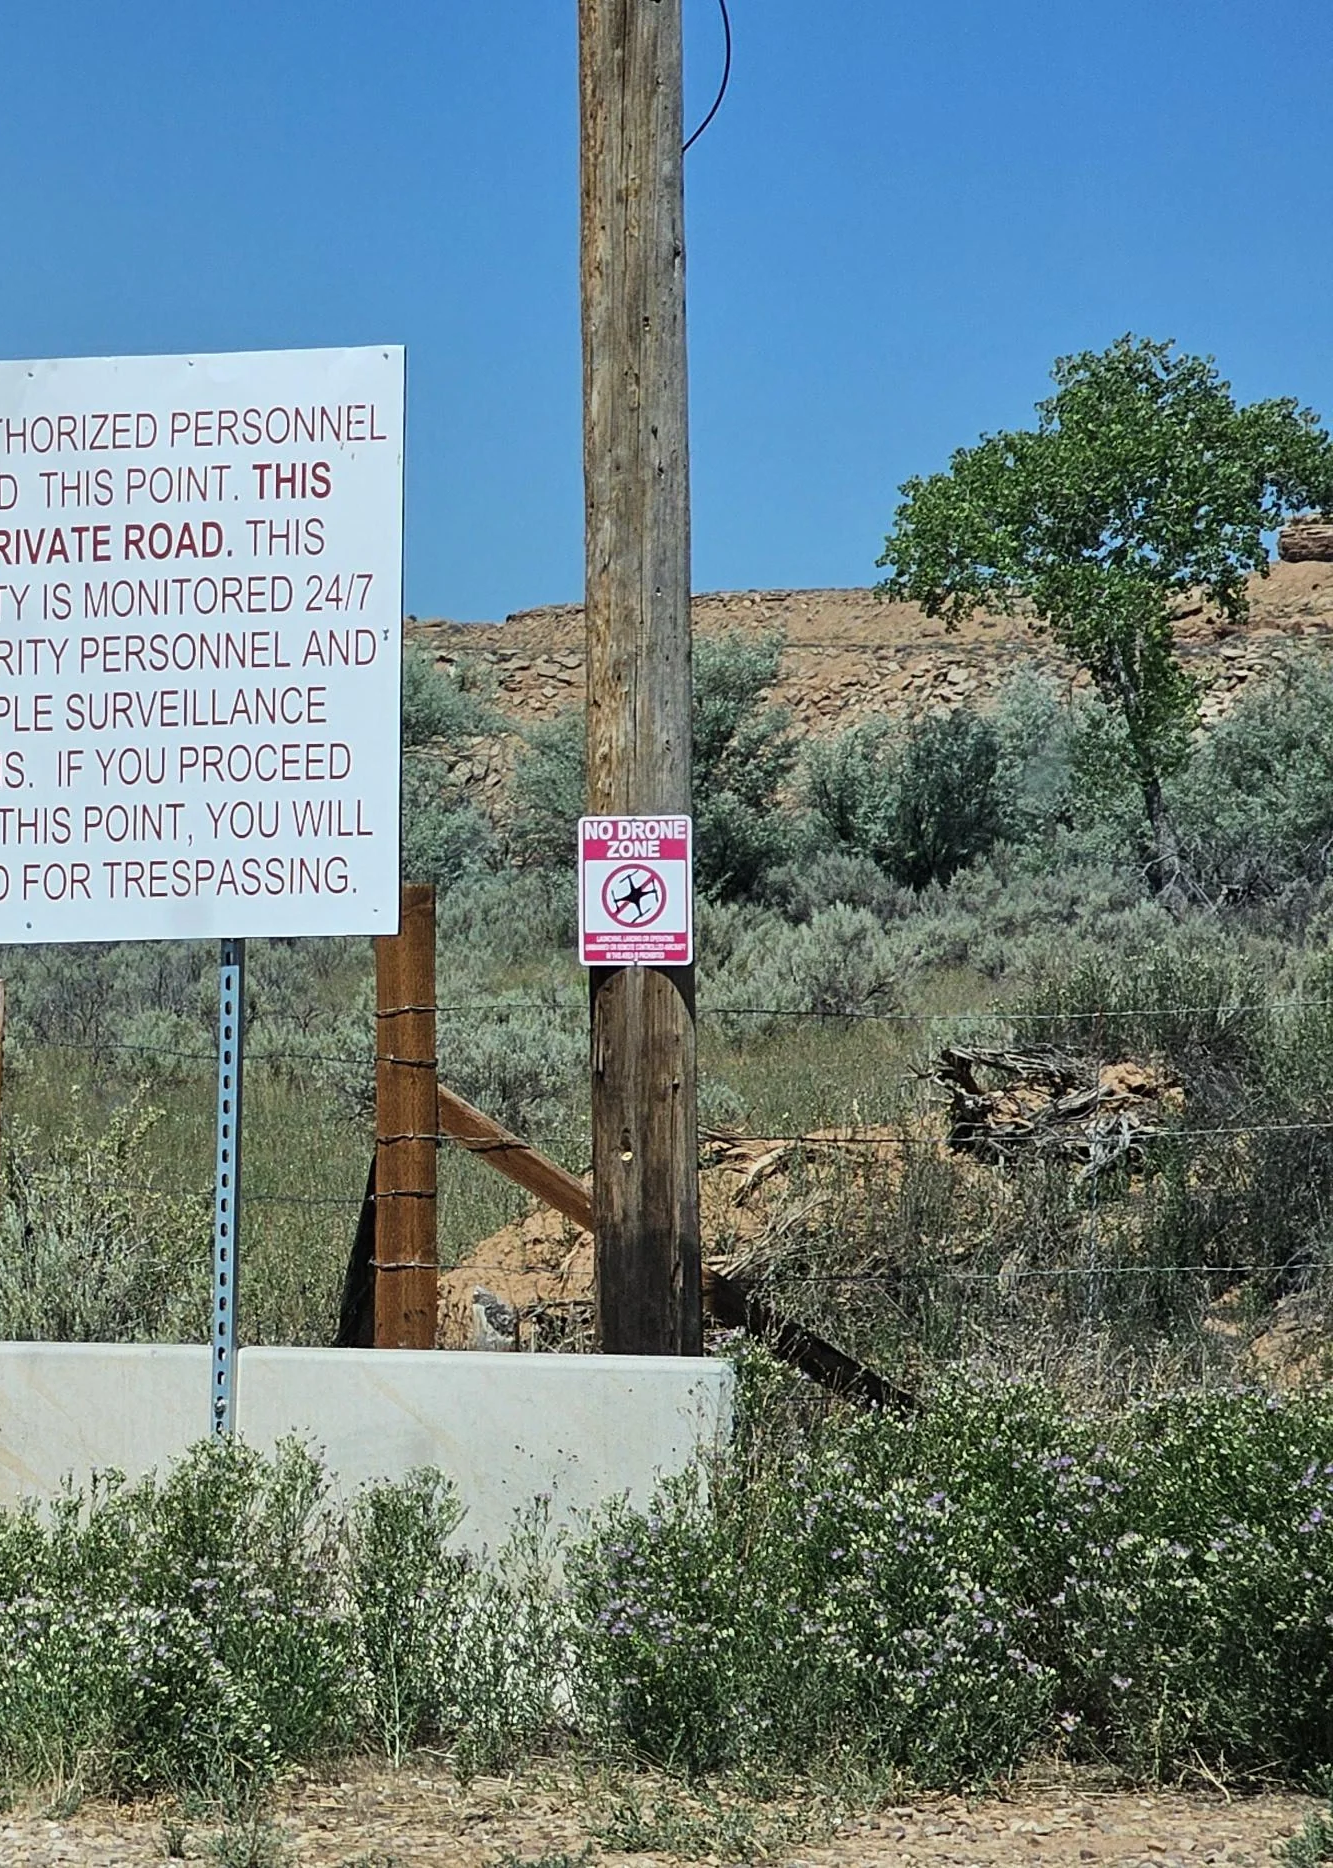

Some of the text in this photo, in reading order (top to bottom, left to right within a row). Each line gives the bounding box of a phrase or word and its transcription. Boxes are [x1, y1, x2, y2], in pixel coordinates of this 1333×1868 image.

[171, 404, 387, 450] PERSONNEL
[39, 469, 113, 508] THIS
[127, 465, 238, 504] POINT.
[252, 462, 331, 500] THIS
[125, 521, 232, 560] ROAD.
[245, 518, 324, 556] THIS
[44, 583, 71, 620] IS
[85, 576, 293, 618] MONITORED
[305, 573, 373, 611] 24/7
[81, 631, 291, 674] PERSONNEL
[302, 629, 376, 667] AND
[66, 687, 326, 731] SURVEILLANCE
[58, 750, 84, 787] IF
[95, 747, 165, 786] YOU
[180, 743, 351, 783] PROCEED
[84, 803, 192, 846] POINT,
[206, 801, 279, 839] YOU
[292, 800, 373, 837] WILL
[585, 821, 686, 840] NO DRONE
[607, 841, 660, 858] ZONE
[24, 863, 91, 900] FOR
[103, 857, 356, 898] TRESPASSING.
